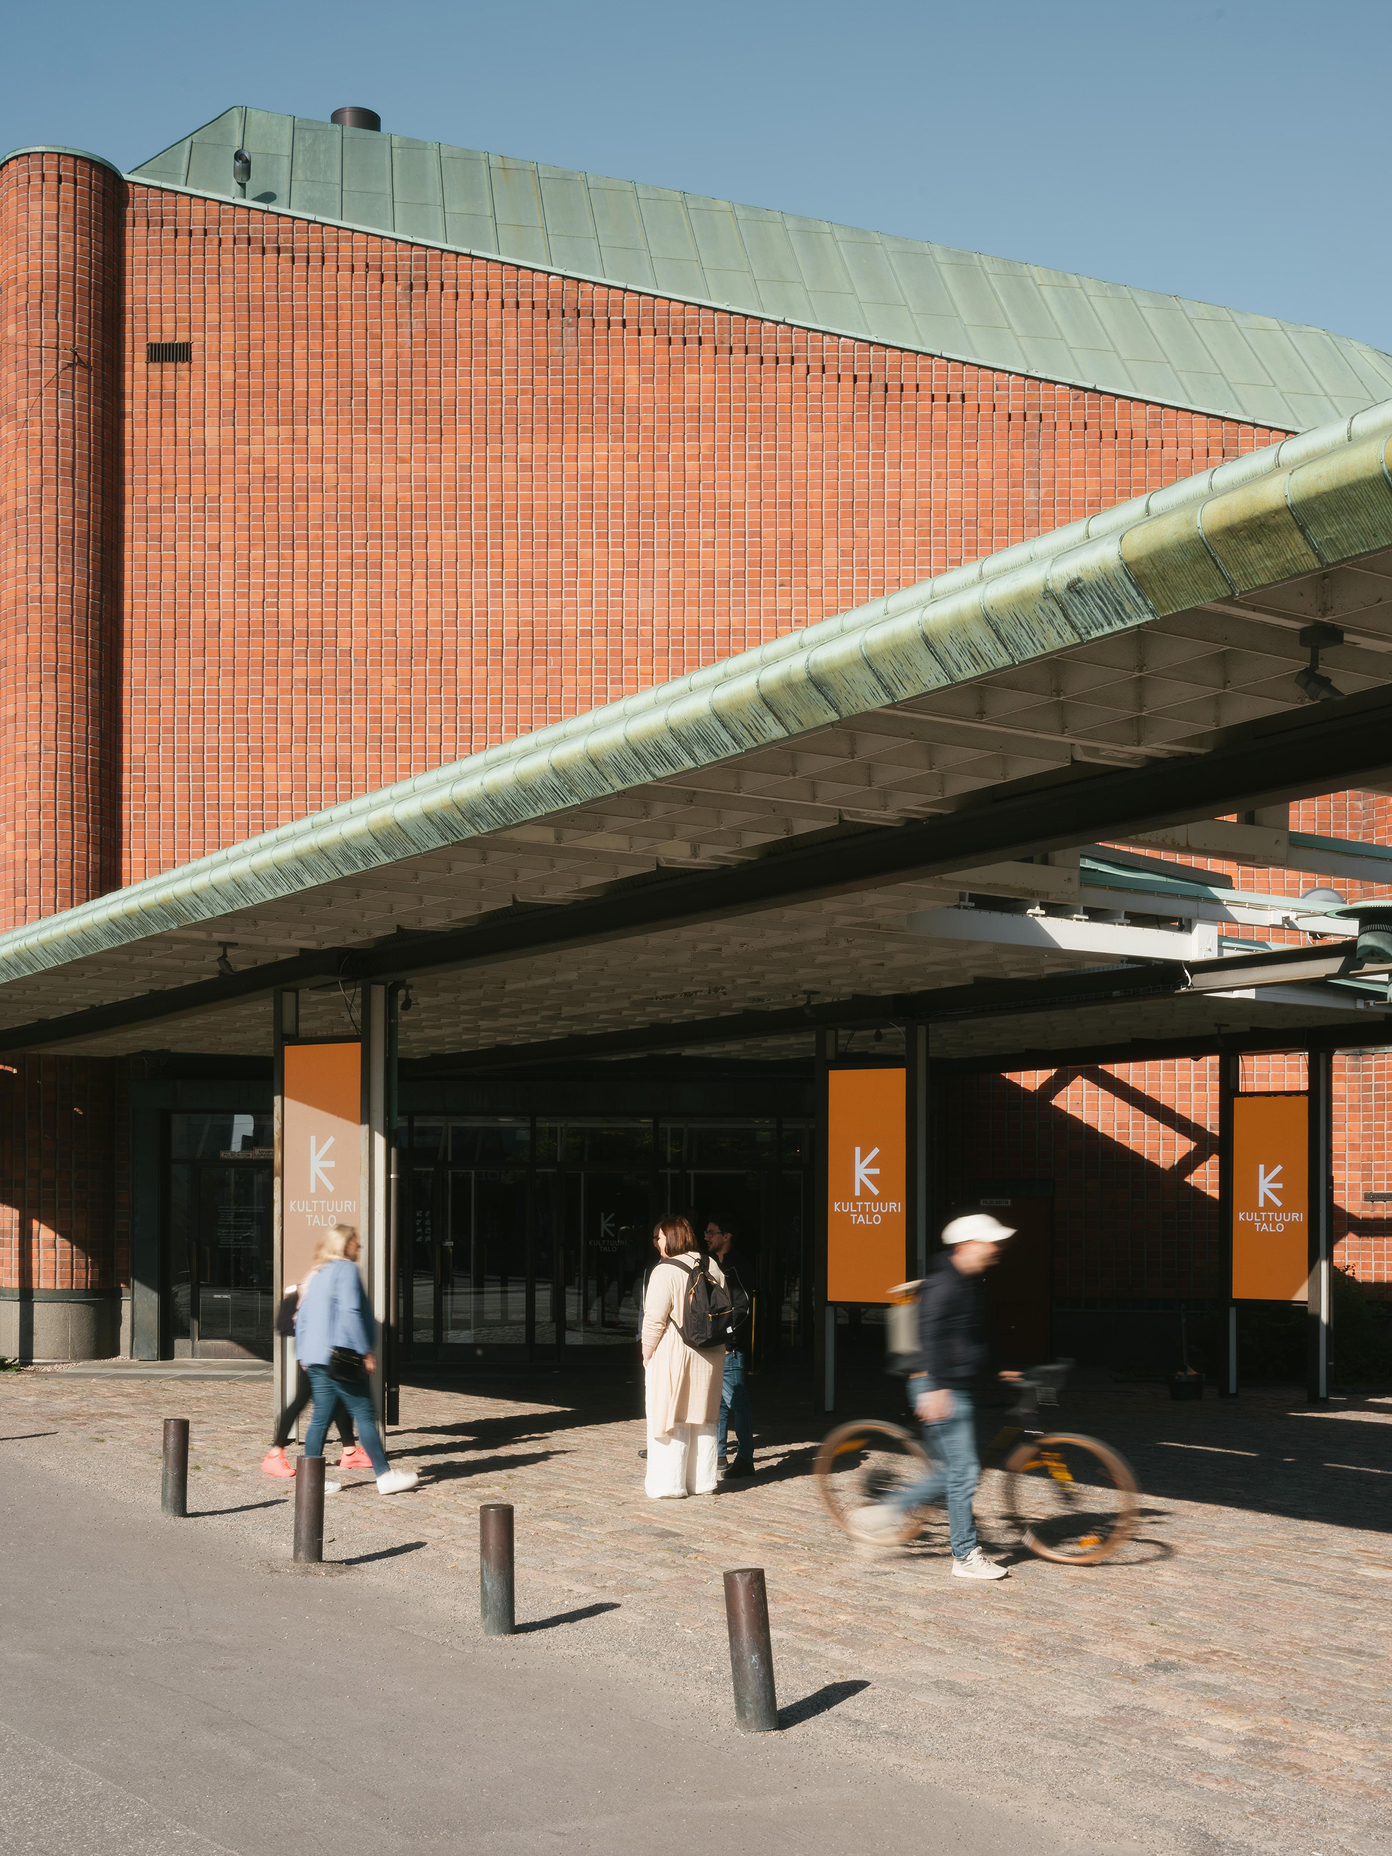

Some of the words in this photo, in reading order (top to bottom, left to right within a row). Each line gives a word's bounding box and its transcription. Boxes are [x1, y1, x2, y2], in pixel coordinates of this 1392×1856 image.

[289, 1200, 357, 1213] KULTTUURI
[834, 1201, 901, 1213] KULTTUURI
[306, 1214, 337, 1227] TALO
[850, 1214, 882, 1225] TALO
[1238, 1211, 1304, 1222] KULTTUURI
[1254, 1222, 1285, 1233] TALO
